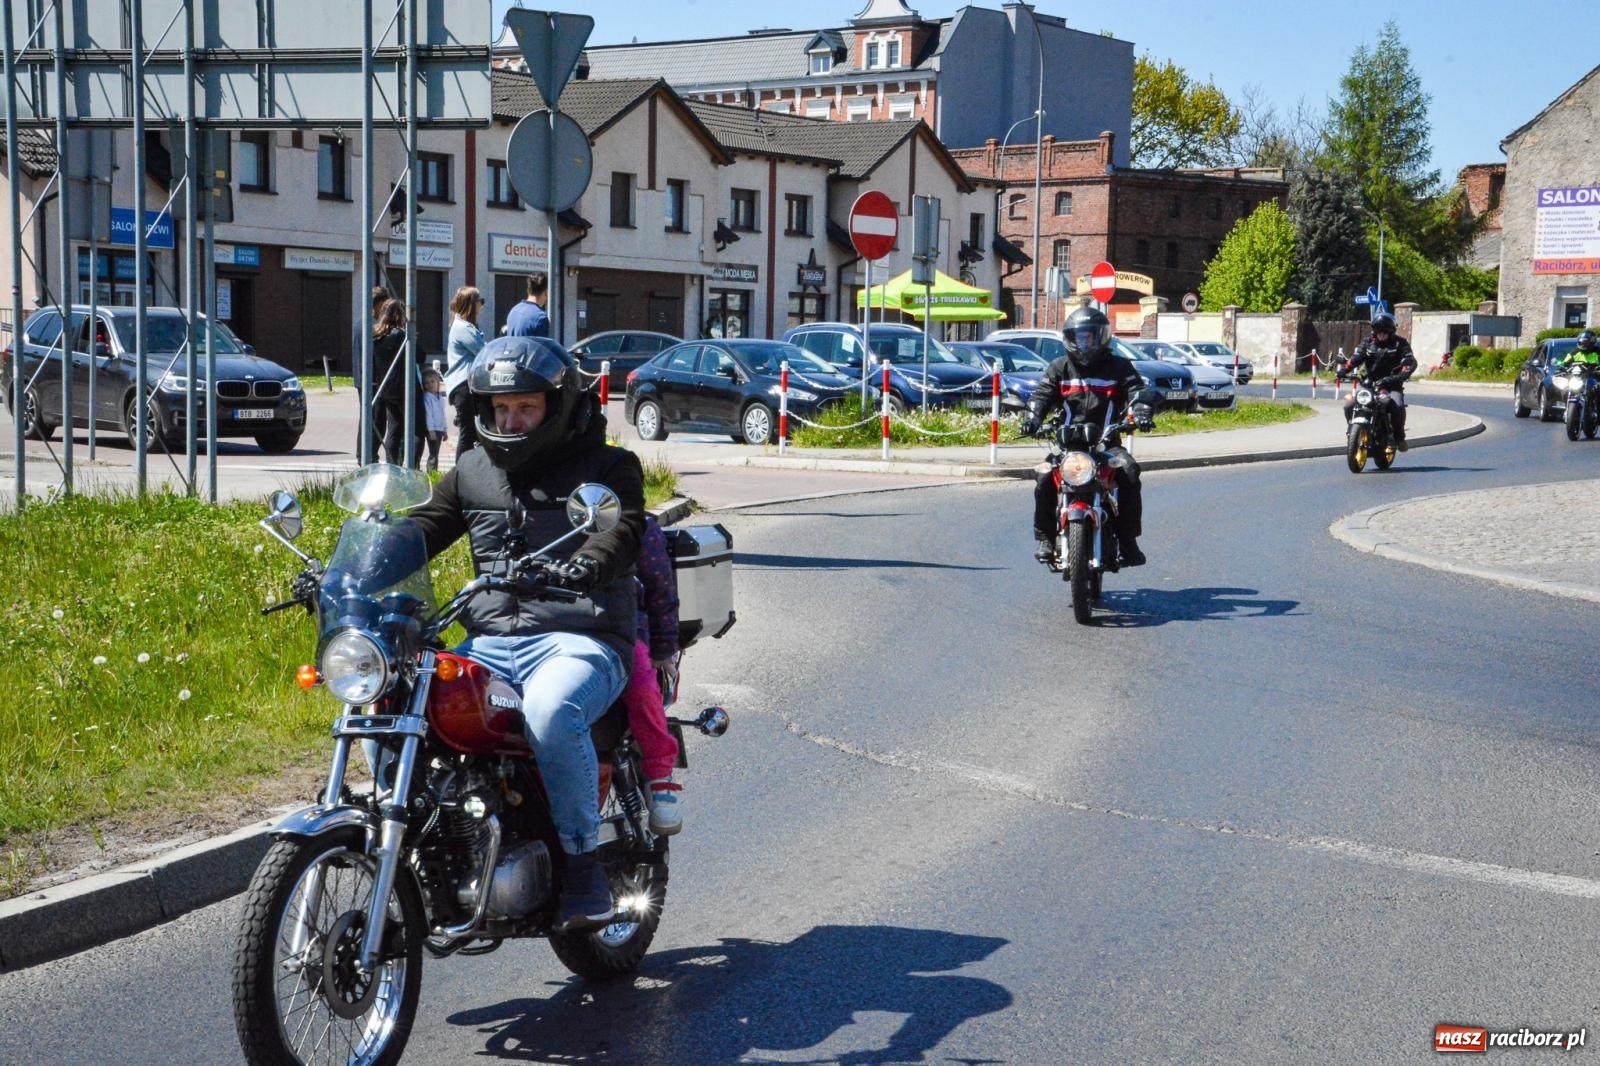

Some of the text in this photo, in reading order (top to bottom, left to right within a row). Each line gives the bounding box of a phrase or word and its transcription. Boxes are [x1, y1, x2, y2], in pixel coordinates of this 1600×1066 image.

[1541, 189, 1600, 205] SALON
[505, 240, 548, 258] dentica
[1535, 260, 1586, 271] Racibórz,
[725, 269, 740, 278] MODA
